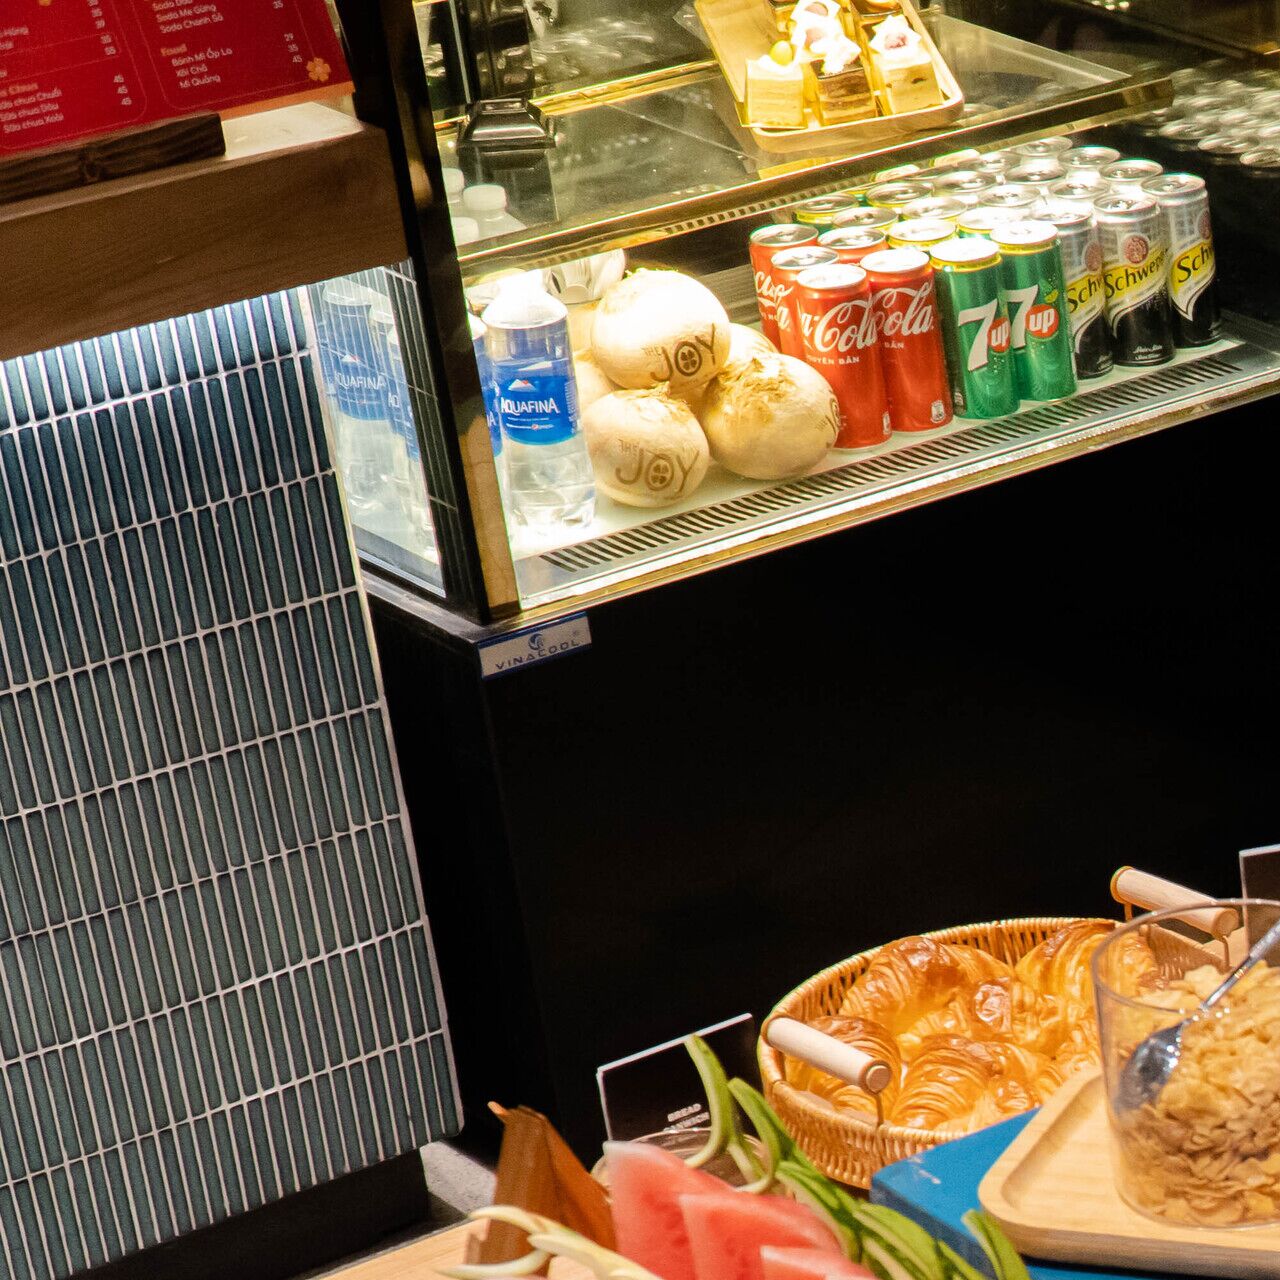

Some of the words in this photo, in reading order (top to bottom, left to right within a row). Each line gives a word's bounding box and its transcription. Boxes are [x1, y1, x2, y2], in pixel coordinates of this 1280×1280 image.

[650, 323, 716, 382] JOY
[501, 397, 561, 416] AQUAFINA
[615, 450, 701, 493] JOY
[495, 640, 579, 670] VINACOOL
[667, 1103, 702, 1122] BREAD
